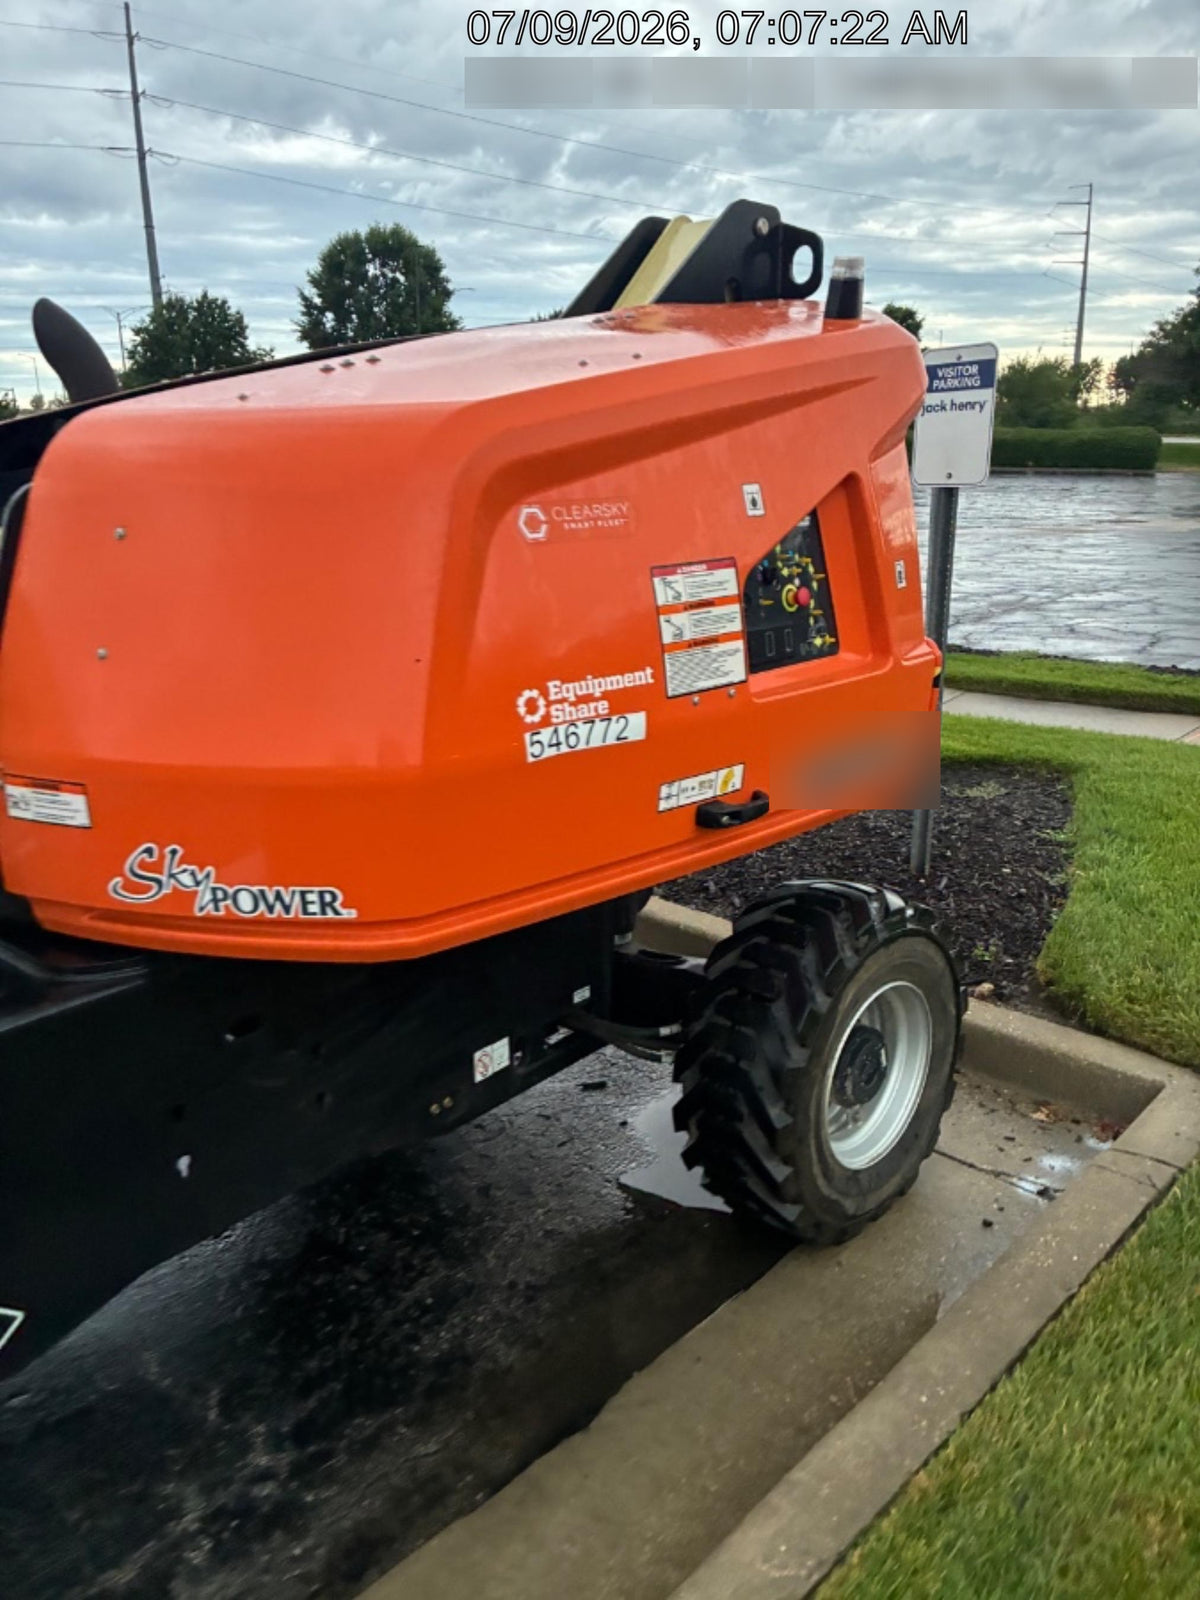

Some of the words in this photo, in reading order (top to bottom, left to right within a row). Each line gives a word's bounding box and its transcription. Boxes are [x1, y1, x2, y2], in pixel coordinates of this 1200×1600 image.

[936, 364, 979, 378] VISITOR
[933, 375, 981, 390] PARKING
[921, 400, 947, 416] jack
[950, 399, 986, 413] henry
[551, 502, 629, 521] CLEARSKY
[547, 666, 654, 701] Equipment
[550, 700, 610, 723] Share
[529, 715, 630, 759] 546772
